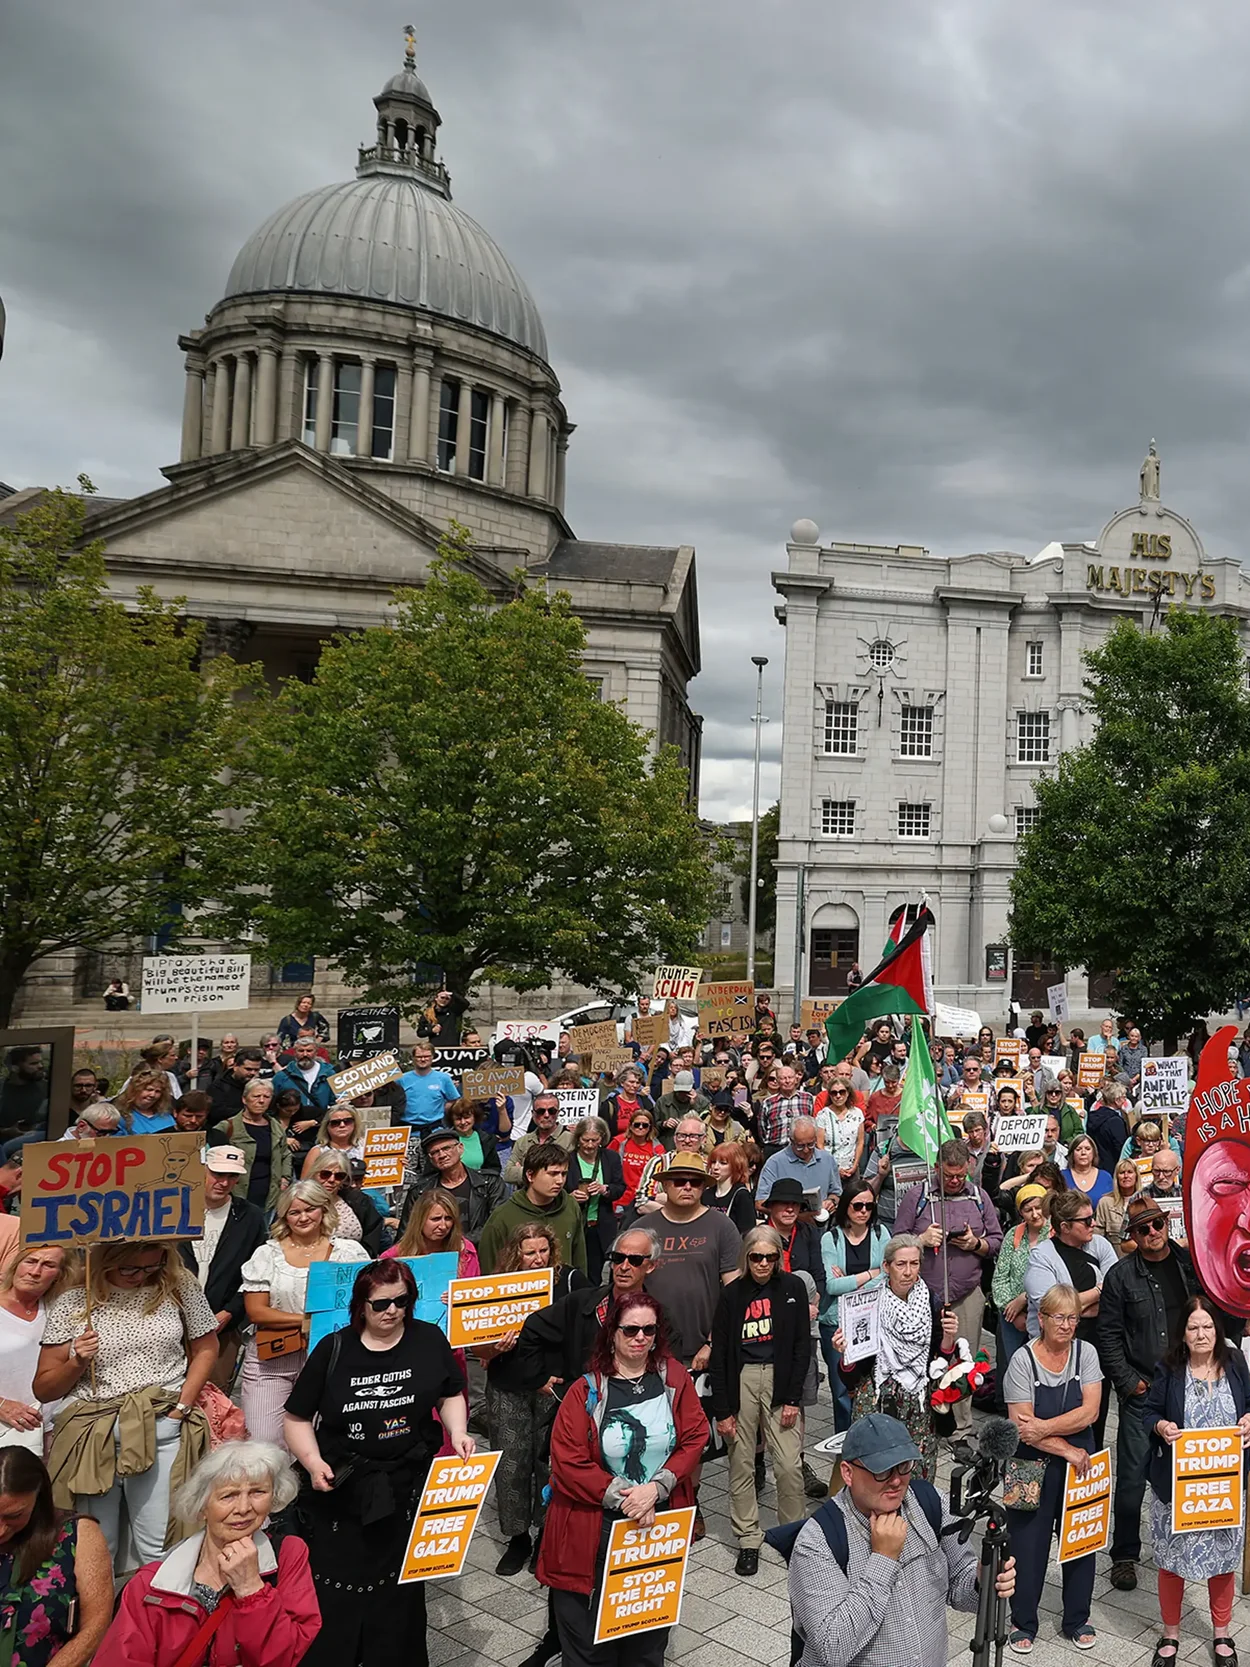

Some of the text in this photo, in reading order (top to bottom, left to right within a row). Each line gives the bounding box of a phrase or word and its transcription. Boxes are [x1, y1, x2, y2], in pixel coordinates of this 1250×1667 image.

[1130, 532, 1172, 559] HIS
[1086, 564, 1216, 597] MAJESTY'S
[200, 958, 238, 966] that
[166, 976, 179, 984] be
[232, 972, 246, 980] of
[654, 979, 694, 998] SCUM
[718, 1008, 734, 1016] TO
[504, 1024, 548, 1036] STOP
[339, 1048, 364, 1060] WE
[334, 1054, 395, 1090] SCOTLAND
[593, 1061, 606, 1070] GO
[1158, 1061, 1178, 1070] WHAT
[1164, 1069, 1183, 1077] THAT
[348, 1072, 388, 1098] TRUMP
[466, 1069, 522, 1084] GO AWAY
[466, 1082, 520, 1096] TRUMP
[1143, 1080, 1178, 1092] AWFUL
[550, 1090, 597, 1102] PSTEIN'S
[965, 1096, 984, 1104] STOP
[1143, 1091, 1188, 1108] SMELL?
[1194, 1080, 1241, 1120] HOPE
[1001, 1118, 1045, 1130] DEPORT
[1197, 1122, 1218, 1142] IS
[1220, 1112, 1235, 1128] A
[372, 1132, 403, 1142] STOP
[998, 1132, 1040, 1146] DONALD
[366, 1142, 406, 1152] TRUMP
[38, 1147, 146, 1192] STOP
[368, 1158, 398, 1168] FREE
[26, 1186, 203, 1243] ISRAEL
[453, 1278, 549, 1301] STOP TRUMP
[846, 1290, 879, 1307] WANTED
[460, 1300, 542, 1321] MIGRANTS
[462, 1311, 535, 1332] WELCOM
[350, 1368, 412, 1387] ELDER GOTHS
[342, 1394, 415, 1414] AGAINST FASCISM
[384, 1416, 407, 1430] YAS
[378, 1426, 412, 1440] QUEENS
[1184, 1437, 1232, 1454] STOP
[1177, 1454, 1240, 1472] TRUMP
[436, 1464, 486, 1484] STOP
[426, 1484, 486, 1506] TRUMP
[1068, 1478, 1110, 1498] TRUMP
[1184, 1480, 1231, 1498] FREE
[1070, 1504, 1104, 1526] FREE
[1181, 1497, 1234, 1515] GAZA
[420, 1515, 468, 1537] FREE
[622, 1522, 680, 1546] STOP
[1067, 1521, 1104, 1545] GAZA
[413, 1536, 460, 1560] GAZA
[611, 1538, 686, 1566] TRUMP
[418, 1566, 432, 1574] TRUMP
[432, 1563, 455, 1572] SCOTLAND
[622, 1569, 666, 1588] STOP
[608, 1580, 676, 1606] THE FAR
[614, 1596, 666, 1619] RIGHT
[606, 1615, 670, 1634] STOP TRUMP SCOTLAND
